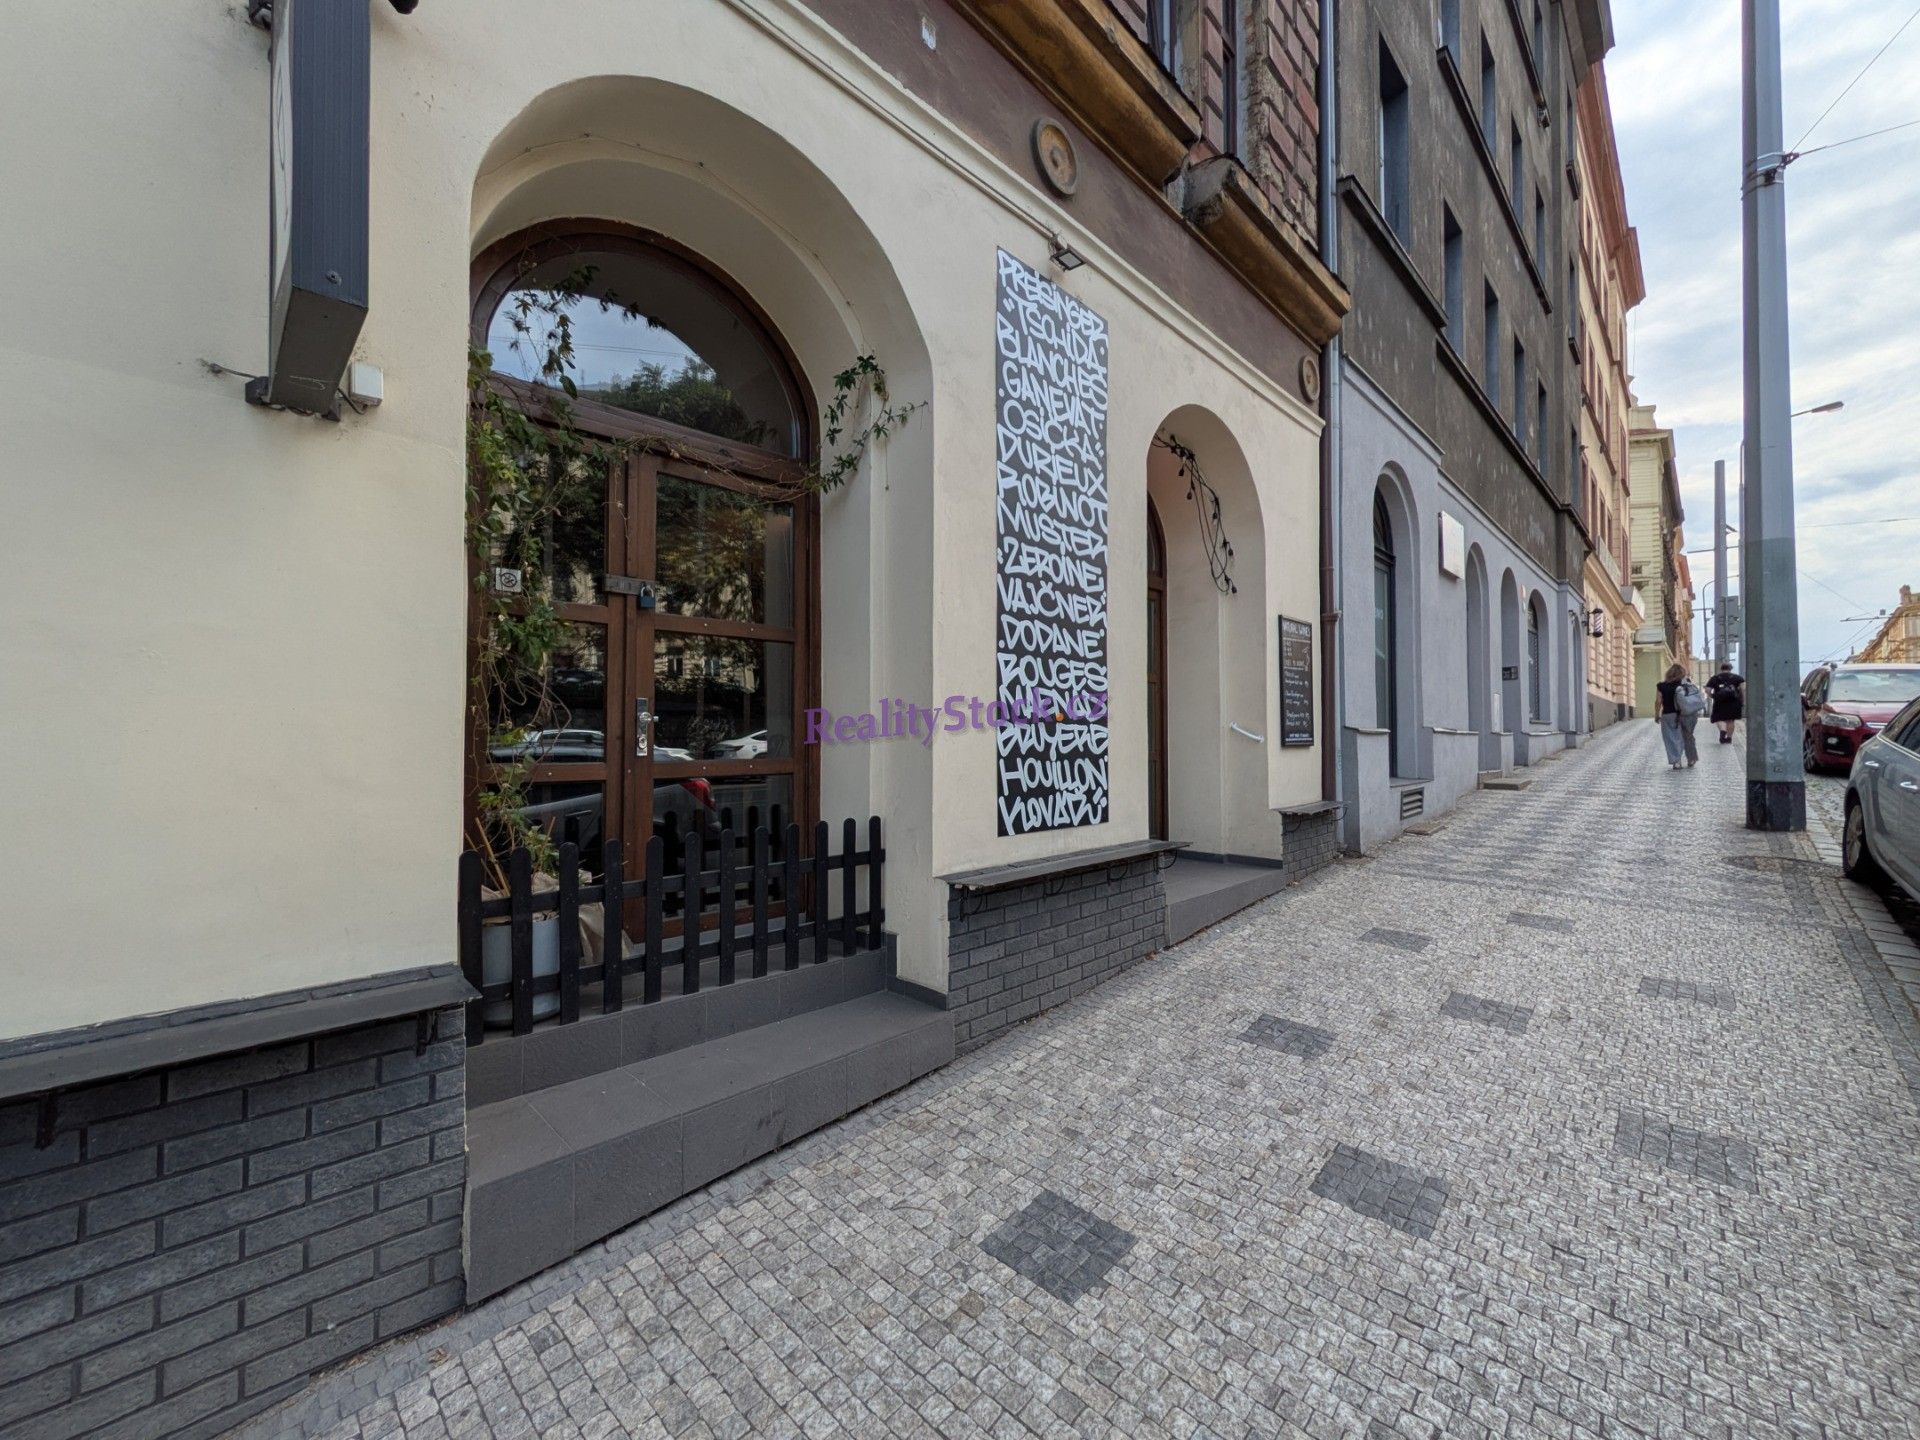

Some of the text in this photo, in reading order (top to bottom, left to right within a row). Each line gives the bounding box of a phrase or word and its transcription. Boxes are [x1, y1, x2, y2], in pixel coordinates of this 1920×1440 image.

[997, 311, 1107, 411] BLANCHES
[997, 423, 1106, 498] DURIEUX
[998, 460, 1107, 534] ROBINOT
[997, 495, 1107, 564] MUSTER
